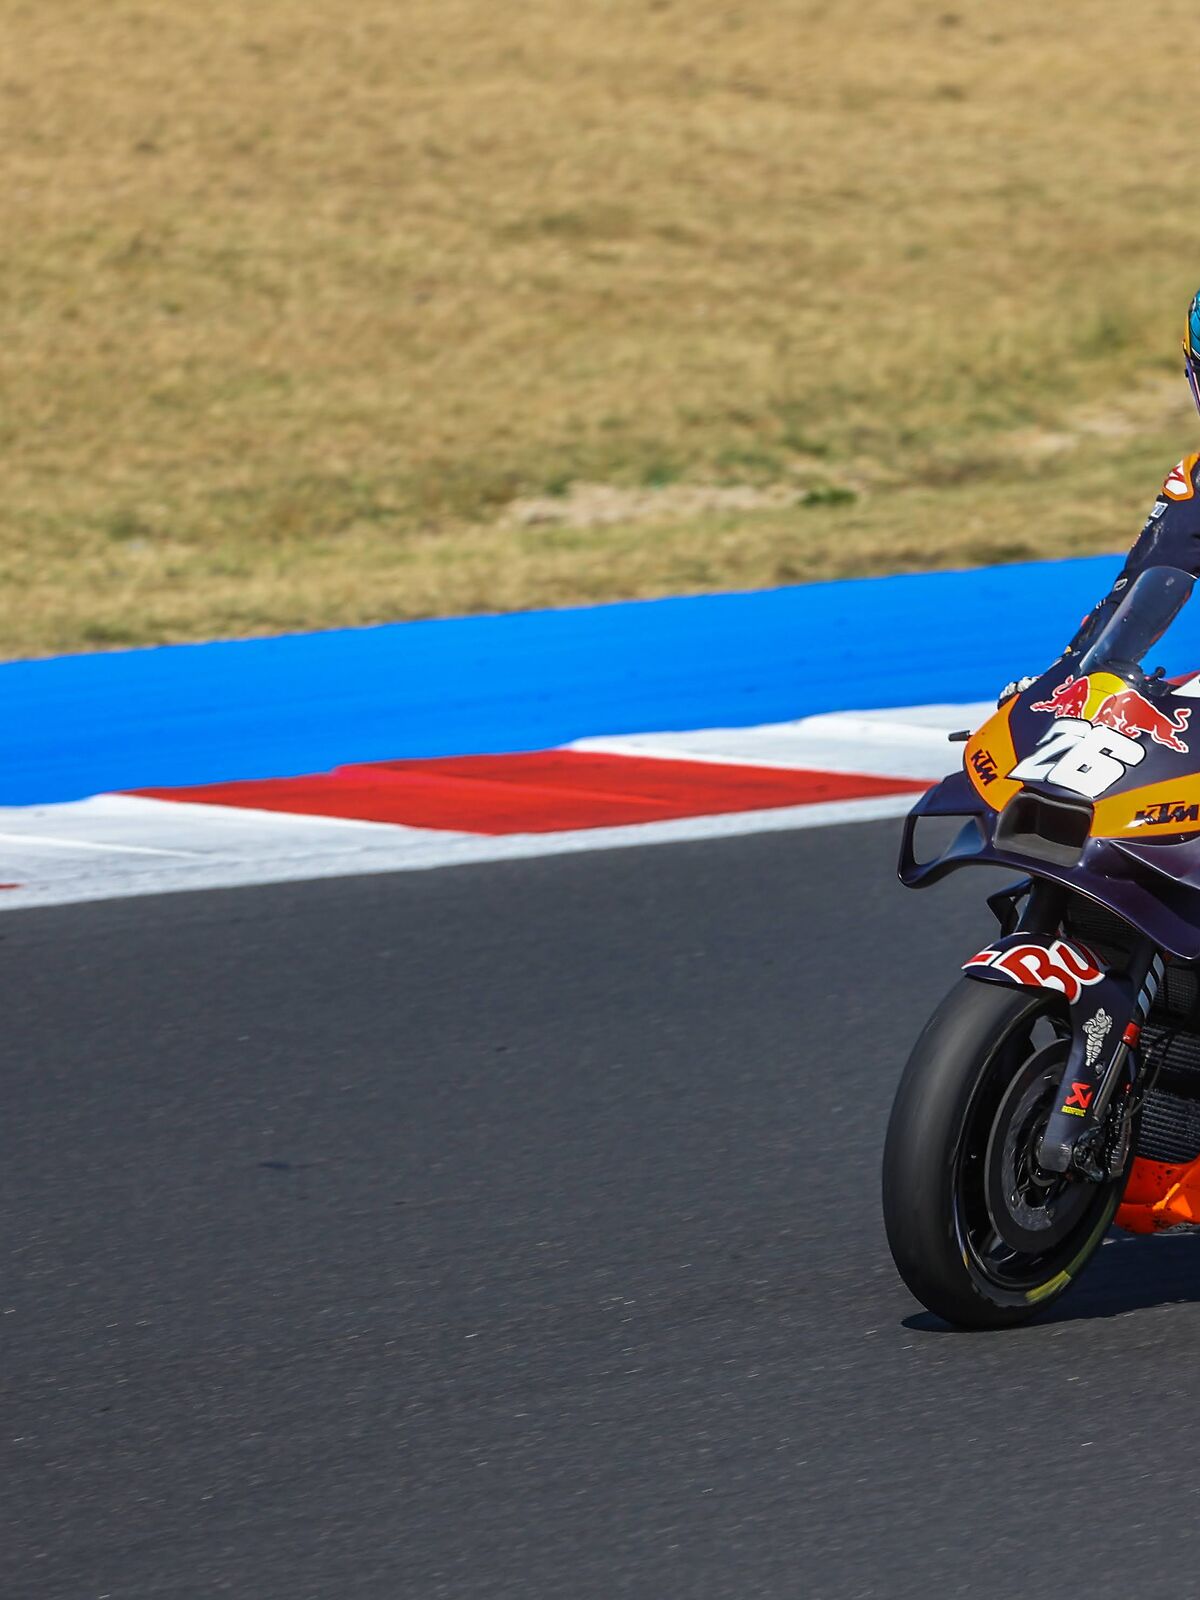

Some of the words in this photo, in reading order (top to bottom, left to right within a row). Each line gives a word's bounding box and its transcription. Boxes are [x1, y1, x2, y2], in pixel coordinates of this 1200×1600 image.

[971, 749, 998, 786] KTM
[1006, 717, 1147, 799] 26
[1134, 801, 1200, 827] KTM
